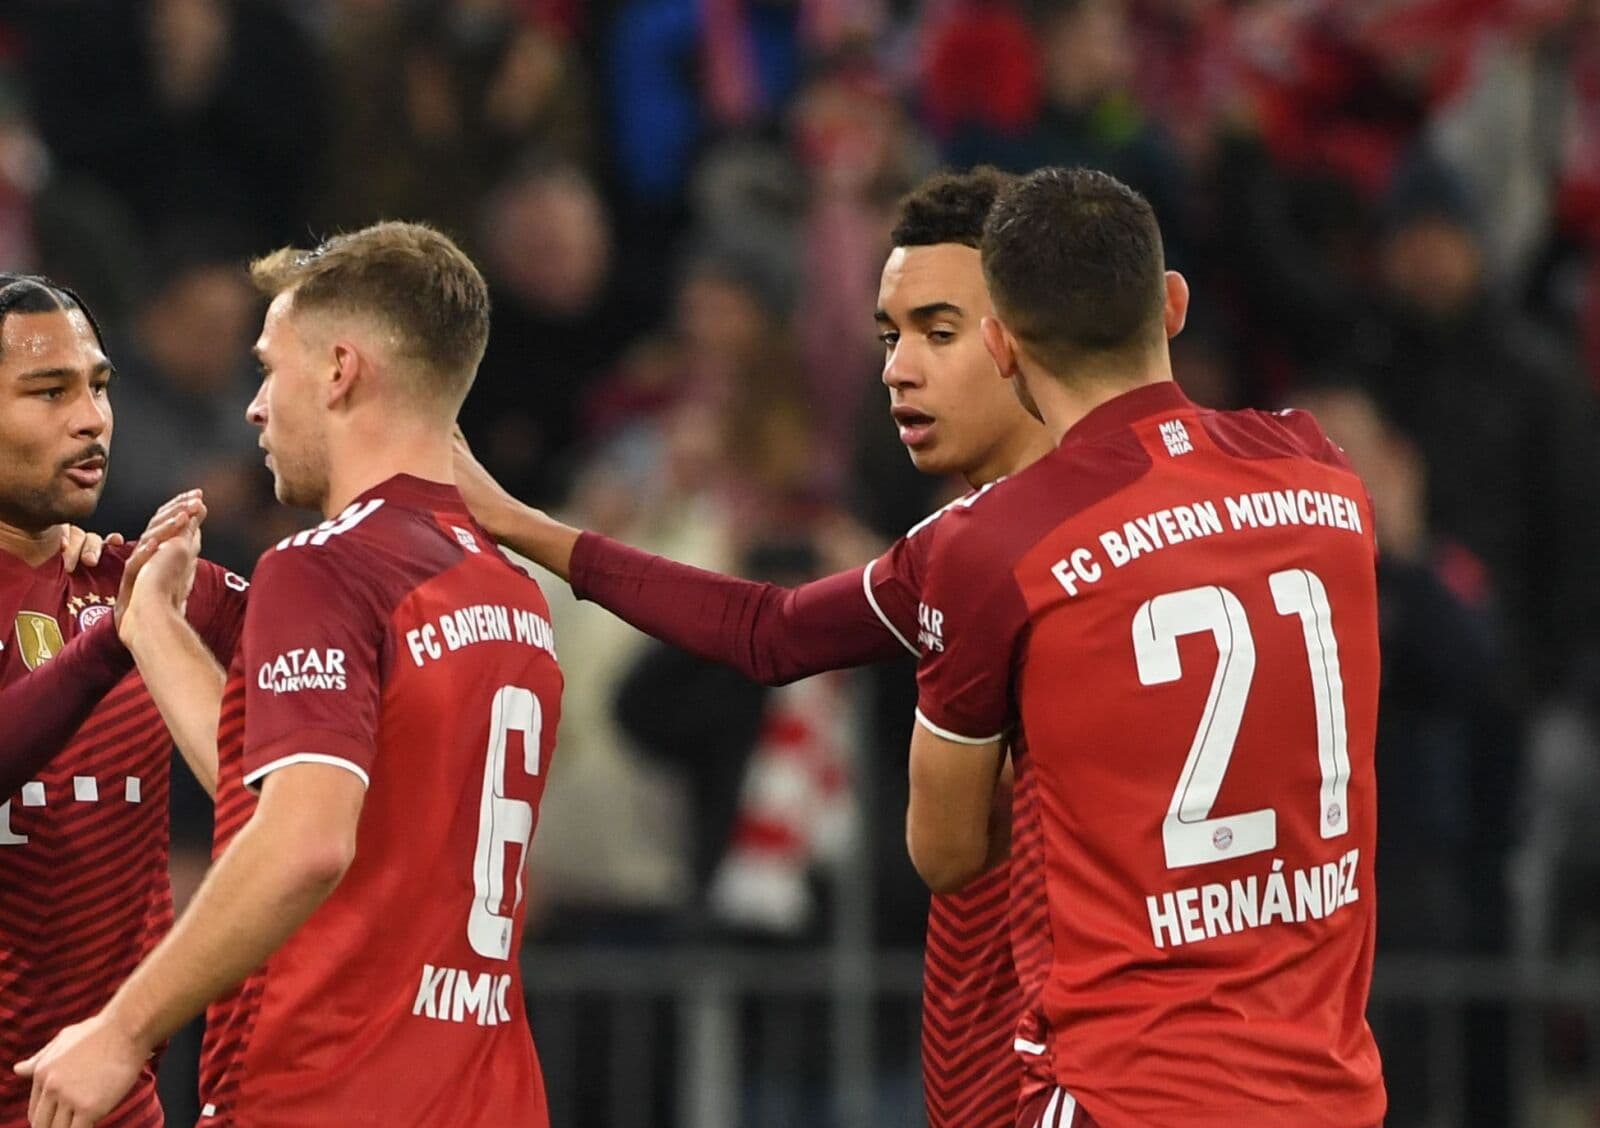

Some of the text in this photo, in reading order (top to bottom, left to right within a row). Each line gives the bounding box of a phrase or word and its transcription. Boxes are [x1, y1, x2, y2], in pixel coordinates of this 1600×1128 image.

[1158, 419, 1185, 436] MIA
[1162, 429, 1190, 447] SAN
[1167, 441, 1194, 457] MIA
[1050, 489, 1363, 597] FC BAYERN MÜNCHEN
[405, 622, 442, 668] FC
[438, 604, 512, 651] BAYERN
[257, 647, 347, 690] QATAR
[273, 673, 347, 697] AIRWAYS
[1131, 568, 1352, 870] 21
[467, 685, 543, 961] 6
[1146, 848, 1360, 949] HERNÁNDEZ
